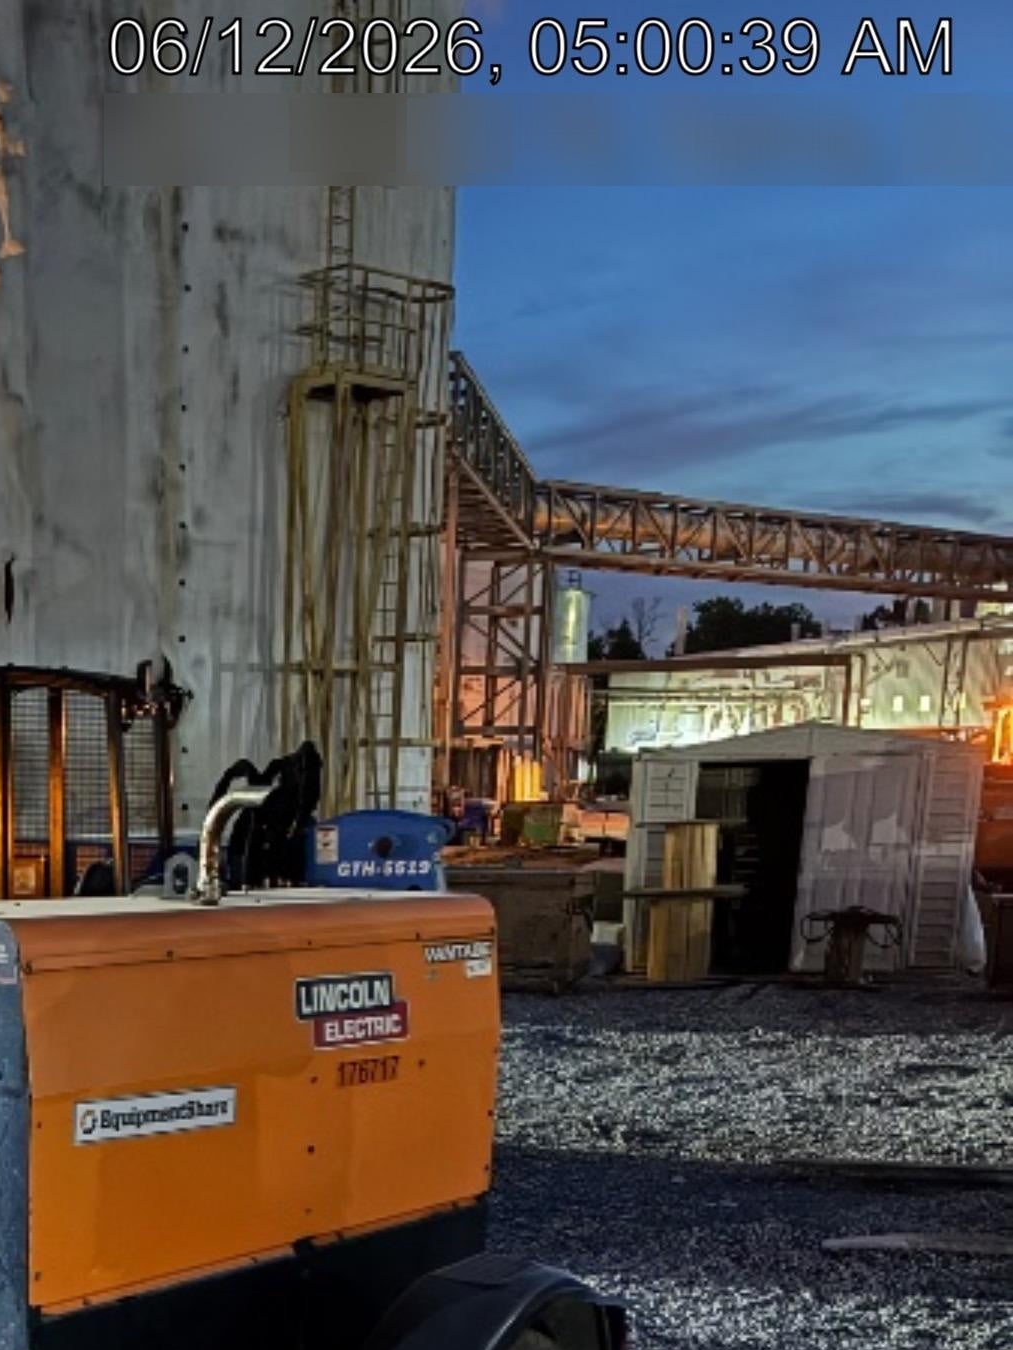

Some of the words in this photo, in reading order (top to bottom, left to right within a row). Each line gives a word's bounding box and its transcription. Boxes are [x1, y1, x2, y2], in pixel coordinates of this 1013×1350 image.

[300, 979, 391, 1015] LINCOLN
[324, 1013, 403, 1042] ELECTRIC
[338, 1056, 401, 1086] 176717
[100, 1100, 229, 1132] EquipmentShare
